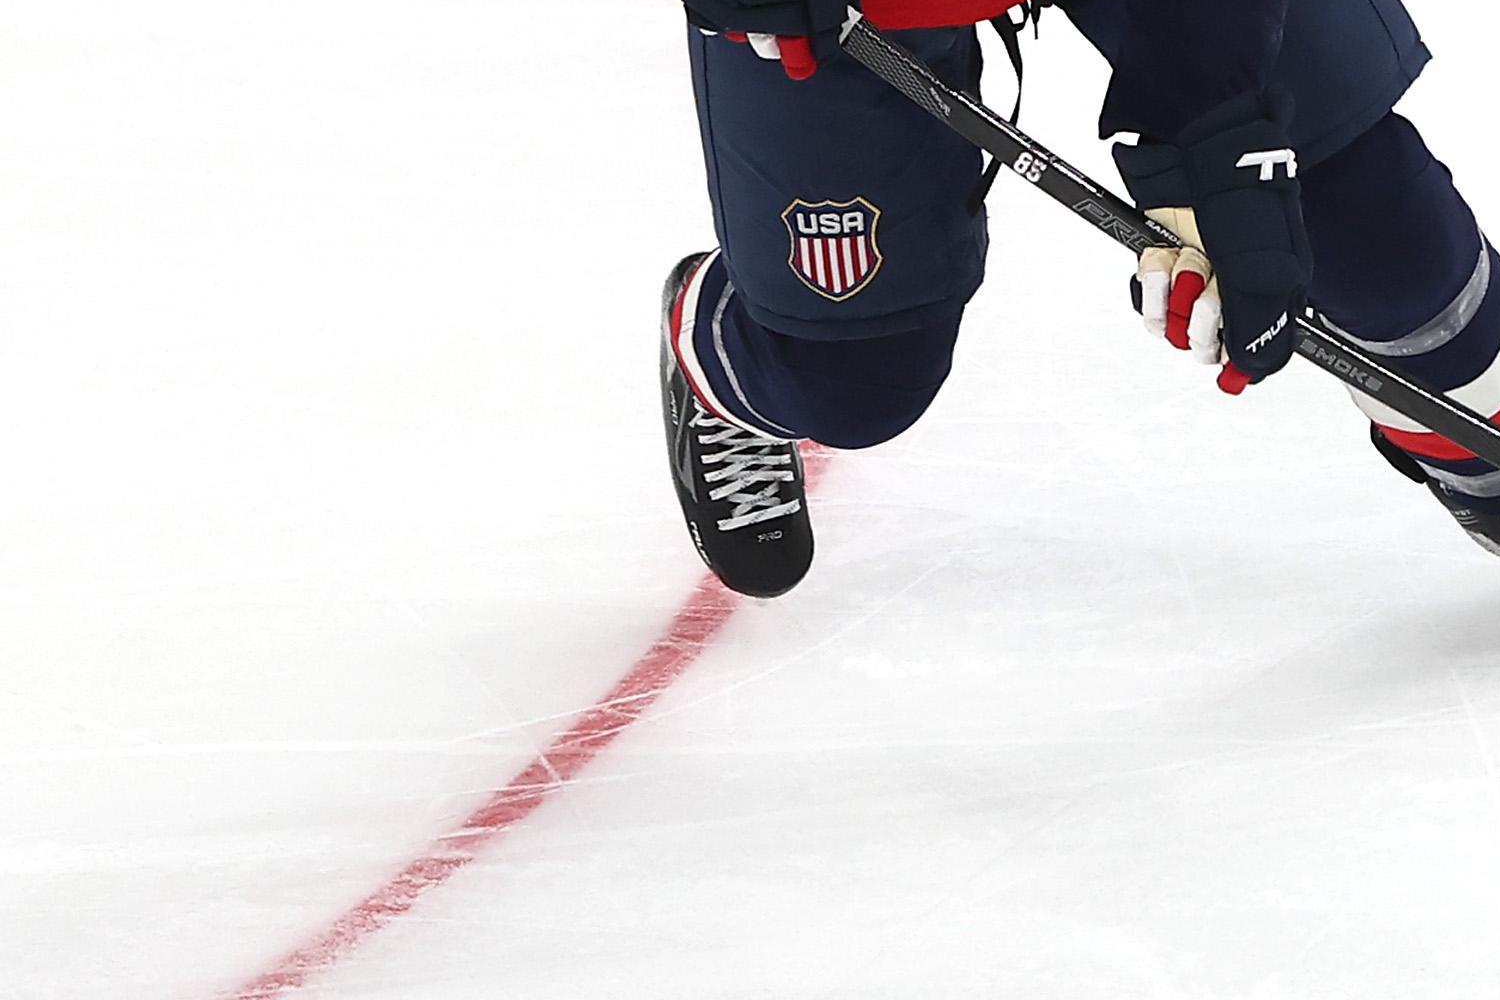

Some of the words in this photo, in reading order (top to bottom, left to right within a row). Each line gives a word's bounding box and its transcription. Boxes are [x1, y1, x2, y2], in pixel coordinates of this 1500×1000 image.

[1013, 151, 1047, 183] 85
[796, 211, 865, 235] USA
[1245, 311, 1288, 353] TRUE
[1299, 338, 1384, 392] SMOKE
